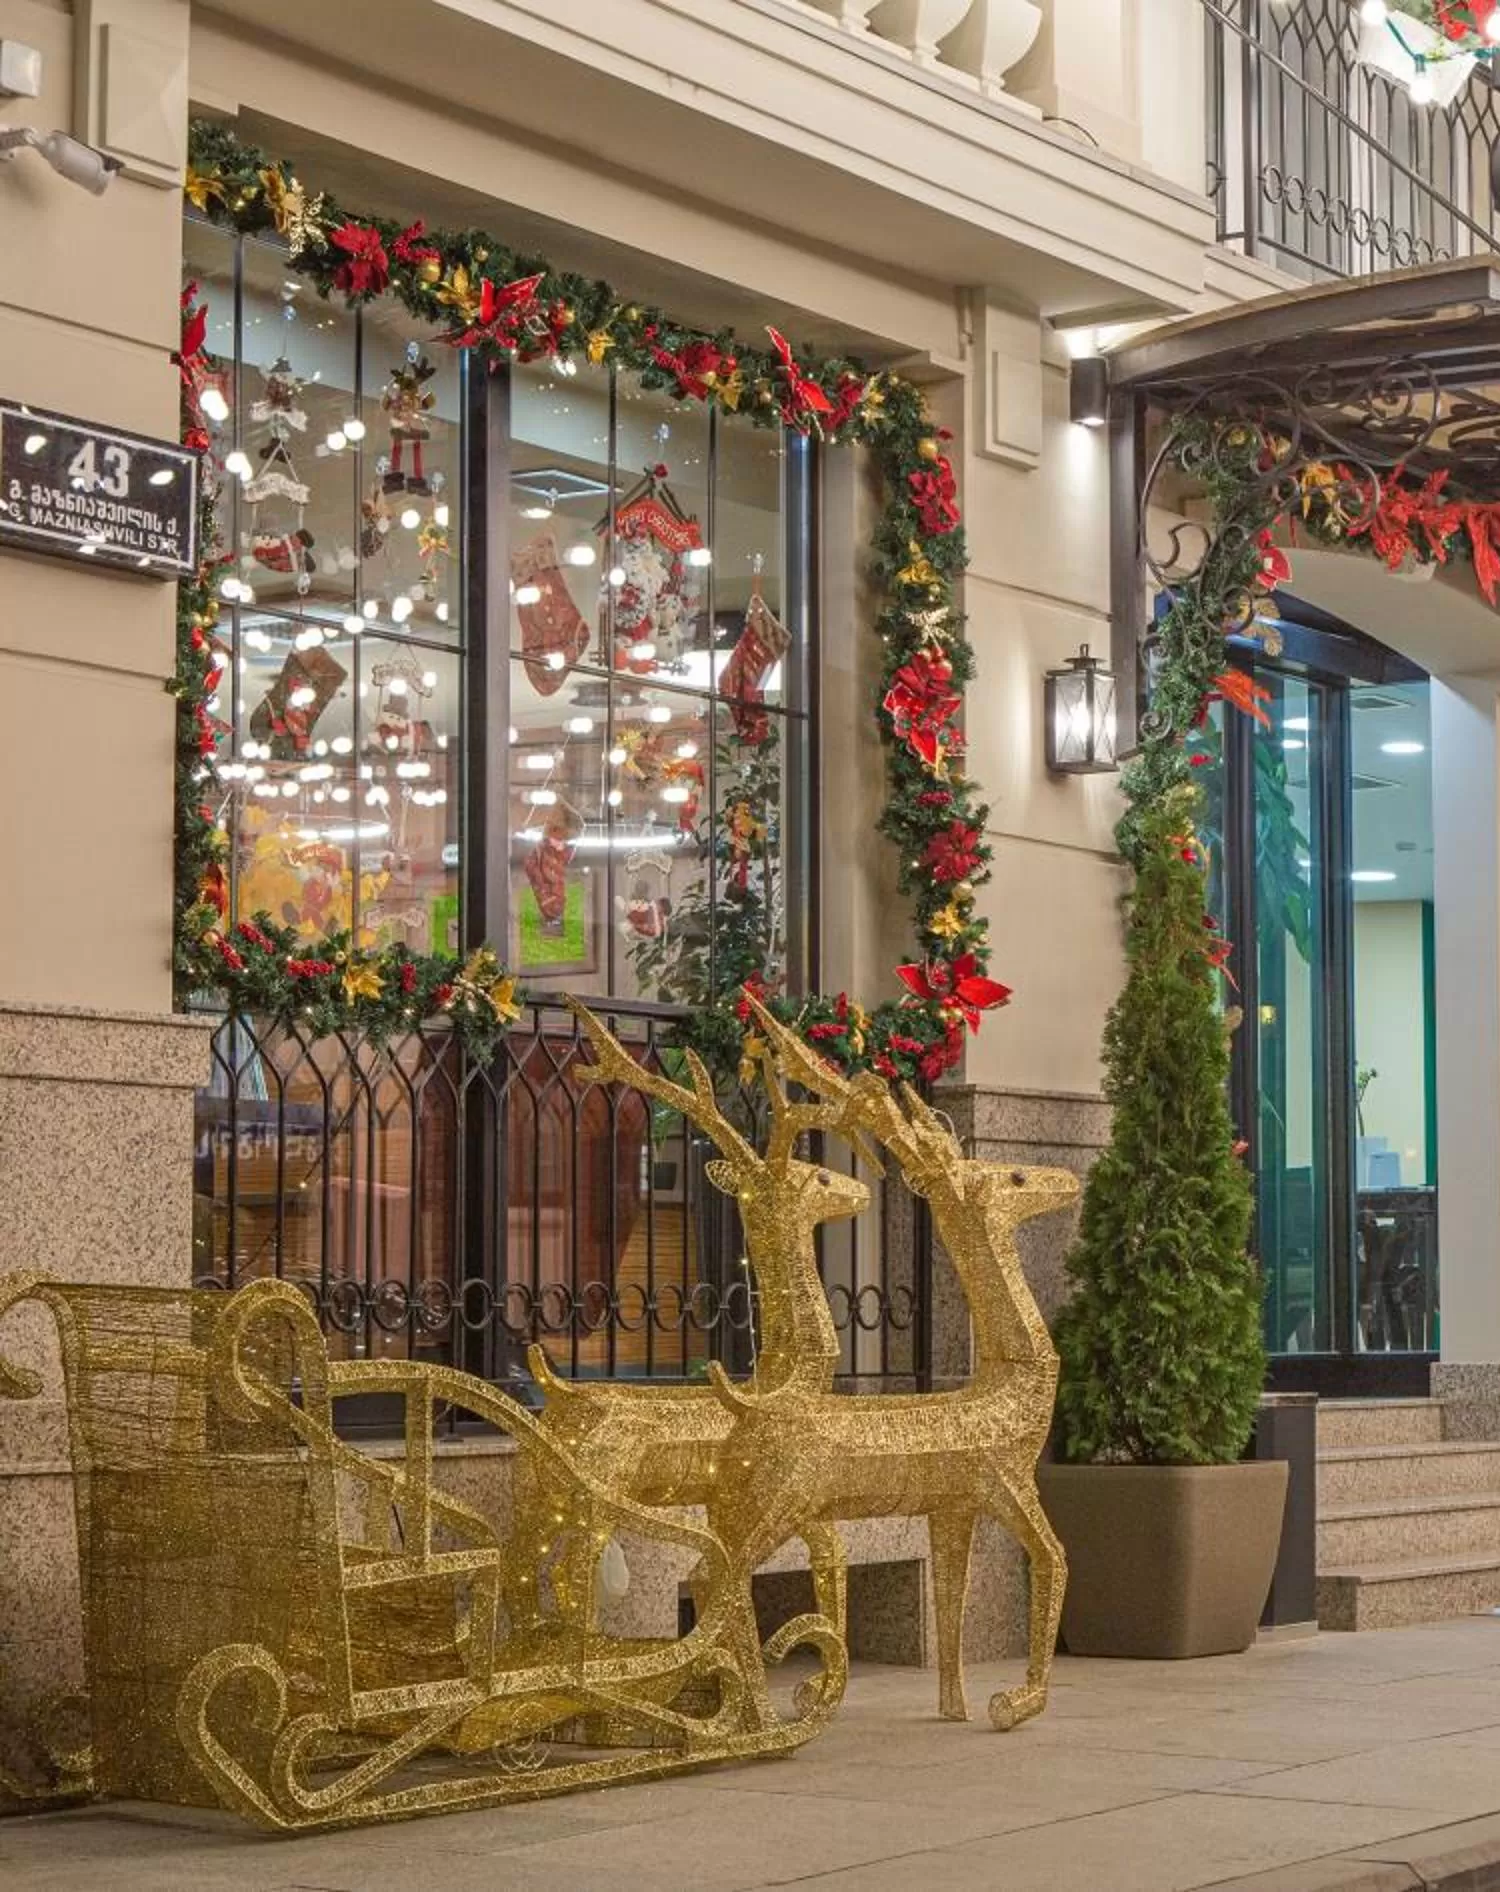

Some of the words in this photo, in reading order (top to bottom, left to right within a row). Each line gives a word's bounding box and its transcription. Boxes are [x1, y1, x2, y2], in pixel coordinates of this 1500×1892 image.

[67, 438, 130, 498] 43
[30, 483, 163, 533] მაზნიაშვილის
[30, 505, 143, 546] MAZNIASHVILI
